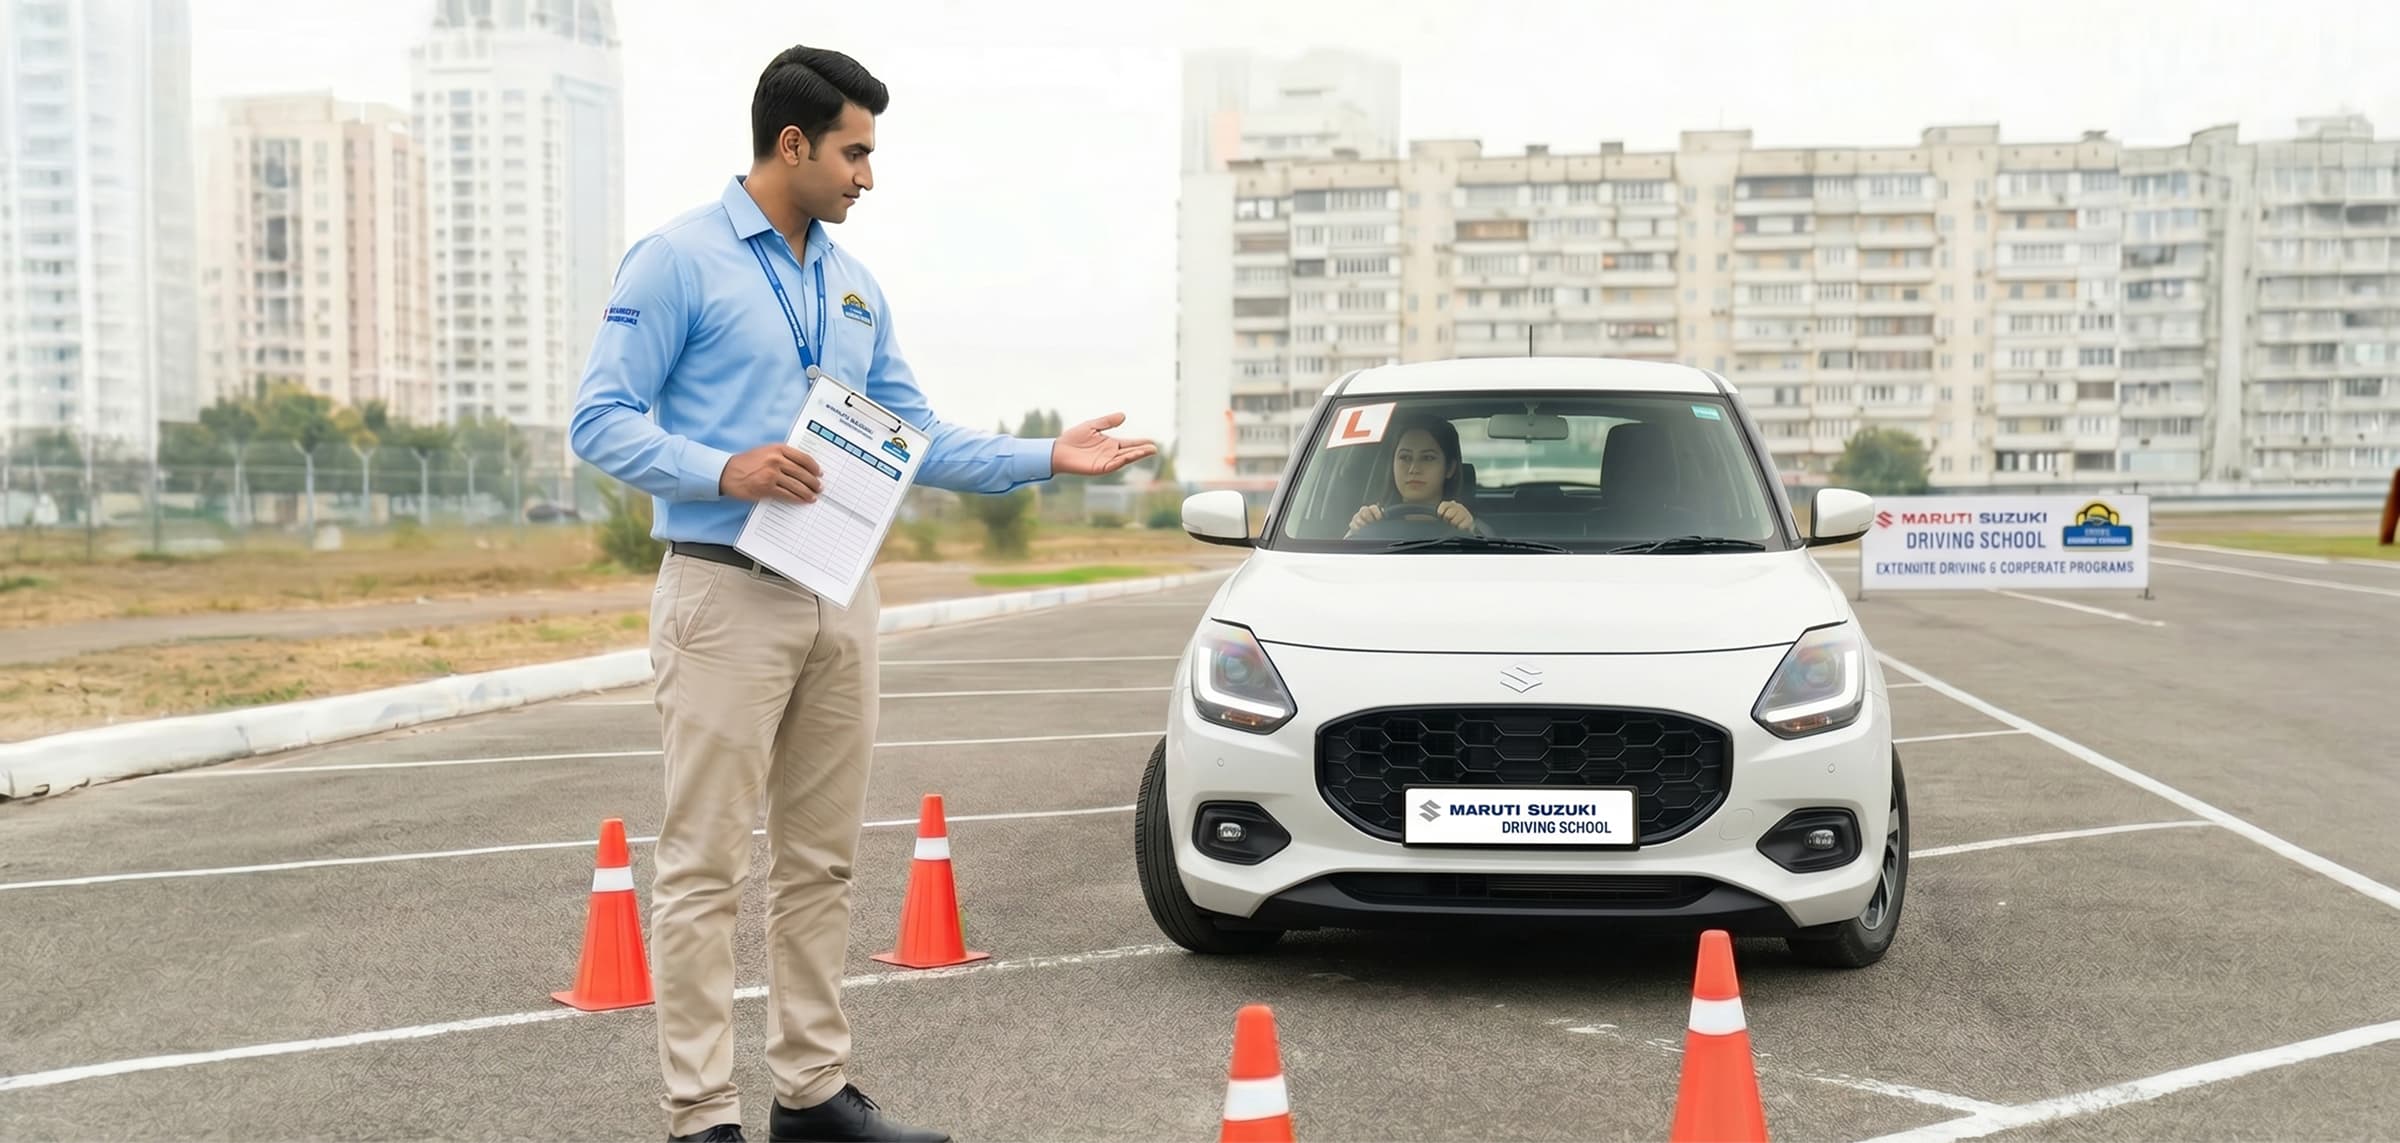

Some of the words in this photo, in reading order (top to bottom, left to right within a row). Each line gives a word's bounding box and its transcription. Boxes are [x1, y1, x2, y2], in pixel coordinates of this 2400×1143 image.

[1342, 410, 1371, 439] L
[1901, 511, 1973, 525] MARUTI
[1978, 511, 2048, 525] SUZUKI
[1906, 530, 1975, 550] DRIVING
[1979, 530, 2047, 550] SCHOOL
[1939, 561, 1987, 575] DRIVING
[2000, 560, 2067, 575] CORPERATE
[2069, 560, 2135, 574] PROGRAMS
[1449, 803, 1521, 817] MARUTI
[1527, 803, 1597, 817] SUZUKI
[1501, 820, 1557, 835] DRIVING
[1558, 820, 1613, 835] SCHOOL
